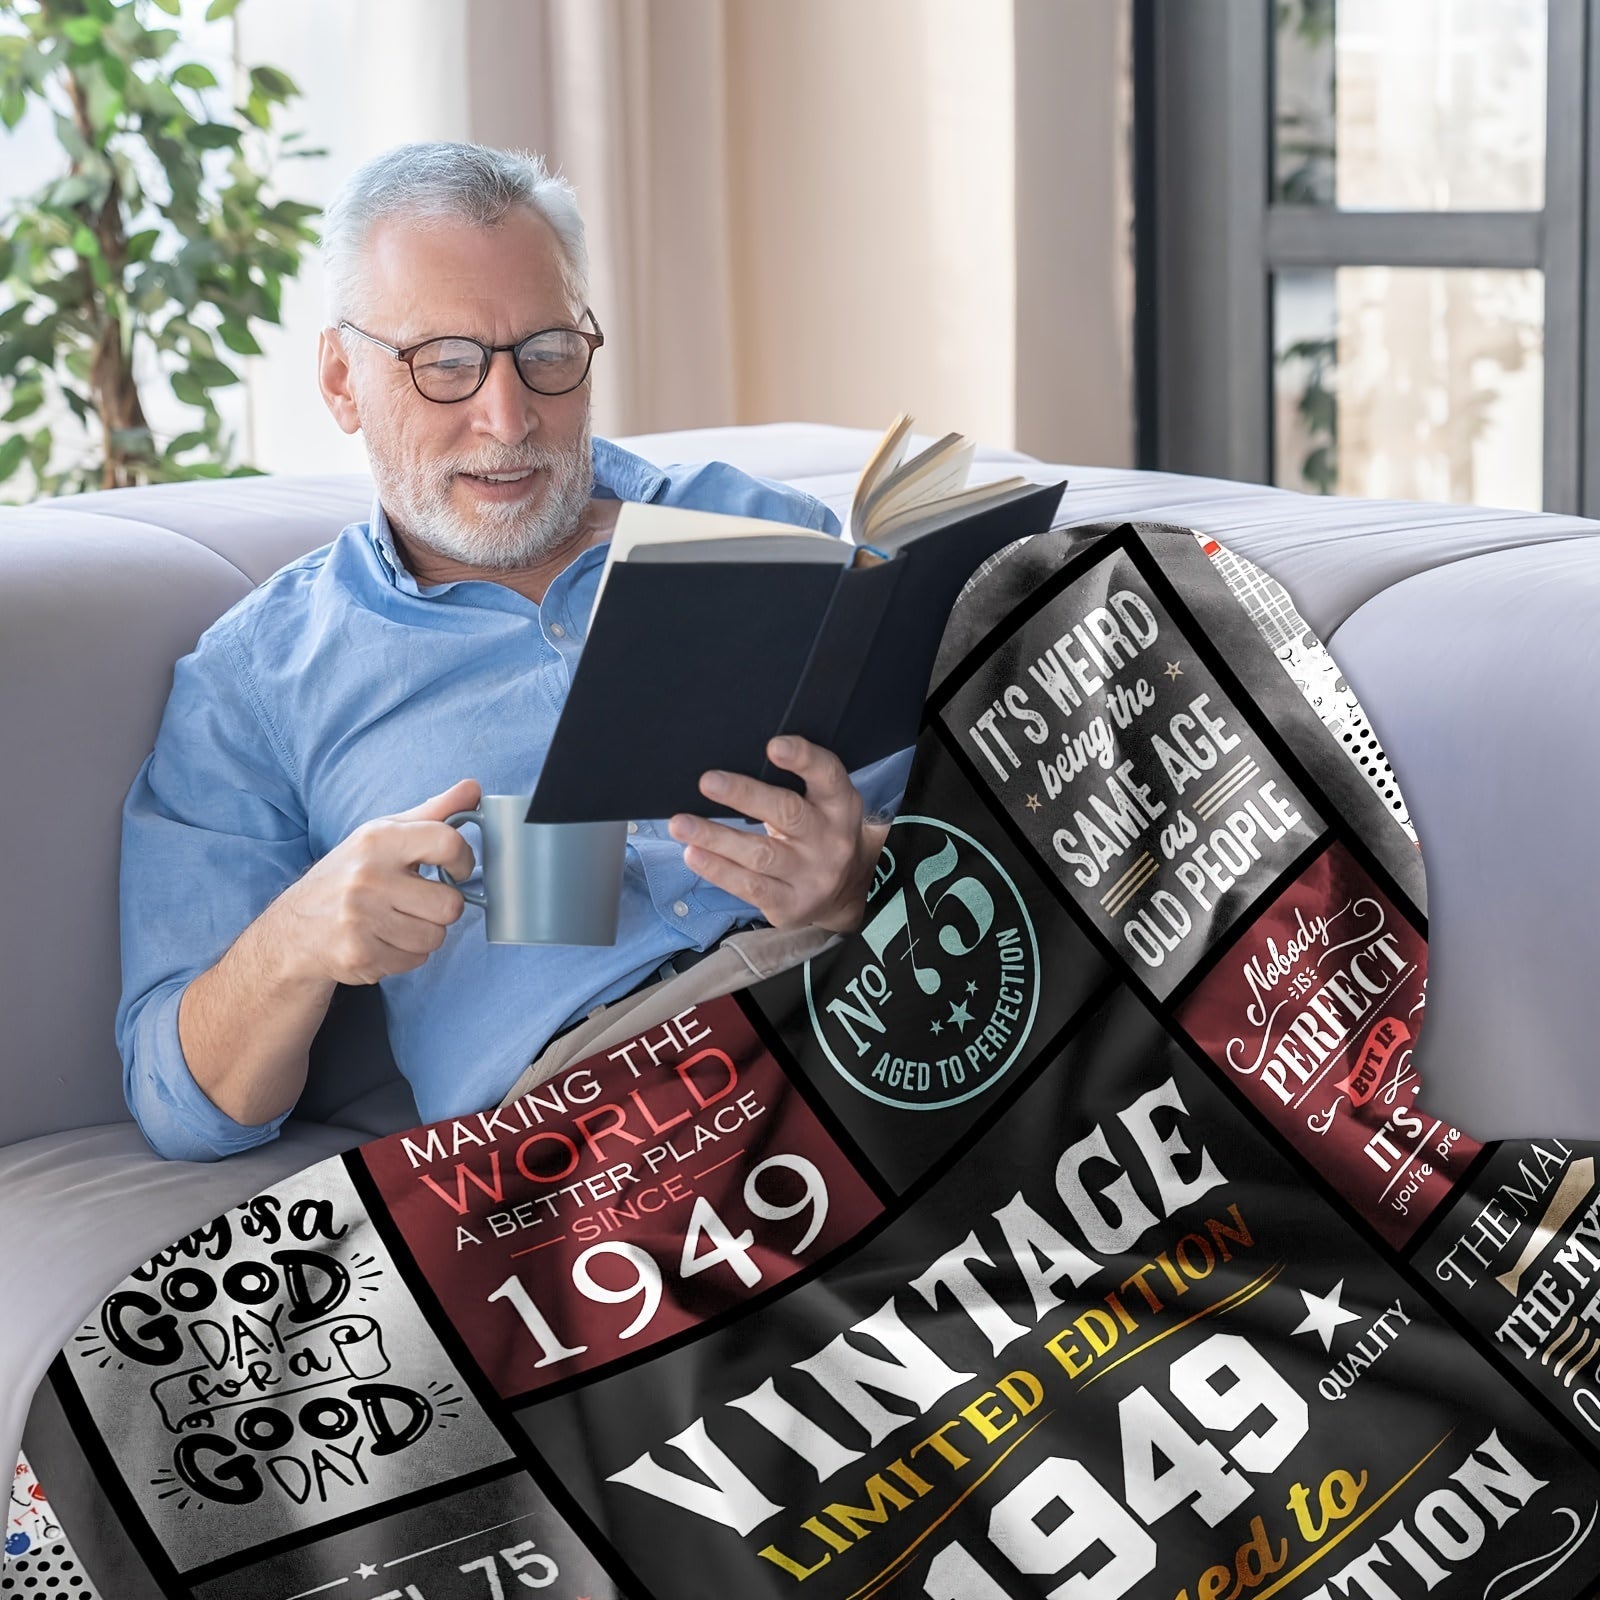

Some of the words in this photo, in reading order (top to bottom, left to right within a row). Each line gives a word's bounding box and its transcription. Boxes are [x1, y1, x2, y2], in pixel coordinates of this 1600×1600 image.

[969, 684, 1049, 782] IT'S
[1028, 590, 1159, 715] WEIRD
[1036, 716, 1114, 800] being
[1105, 678, 1155, 738] the
[1052, 760, 1167, 888] SAME
[1150, 693, 1241, 795] AGE
[1160, 810, 1198, 859] as
[861, 834, 995, 995] 75
[1124, 890, 1193, 967] OLD
[1175, 779, 1302, 912] PEOPLE
[872, 1052, 930, 1091] AGED
[936, 1055, 966, 1088] TO
[965, 927, 1025, 1073] PERFECTION
[1244, 908, 1330, 1027] Nobody
[1260, 933, 1408, 1105] PERFECT
[1294, 973, 1312, 991] IS
[400, 1070, 602, 1169] MAKING
[608, 1006, 712, 1079] THE
[1350, 1050, 1383, 1097] BUT
[1375, 1023, 1396, 1050] IF
[418, 1047, 739, 1216] WORLD
[455, 1226, 482, 1251] A
[486, 1162, 640, 1240] BETTER
[642, 1089, 766, 1175] PLACE
[1363, 1106, 1423, 1173] IT'S
[1392, 1163, 1433, 1216] you're
[287, 1199, 348, 1241] a
[487, 1153, 829, 1368] 1949
[571, 1174, 694, 1243] SINCE
[1436, 1198, 1522, 1290] THE
[100, 1249, 351, 1366] GOOD
[188, 1303, 285, 1370] DAY
[606, 1077, 1229, 1537] VINTAGE
[1495, 1270, 1575, 1360] THE
[1553, 1193, 1600, 1290] MY
[289, 1347, 332, 1376] a
[758, 1369, 1044, 1581] LIMITED
[1044, 1203, 1255, 1380] EDITION
[1318, 1299, 1414, 1402] QUALITY
[173, 1383, 433, 1505] GOOD
[266, 1436, 369, 1505] DAY
[1286, 1469, 1368, 1543] to
[1303, 1427, 1549, 1600] TION
[458, 1540, 559, 1600] 75
